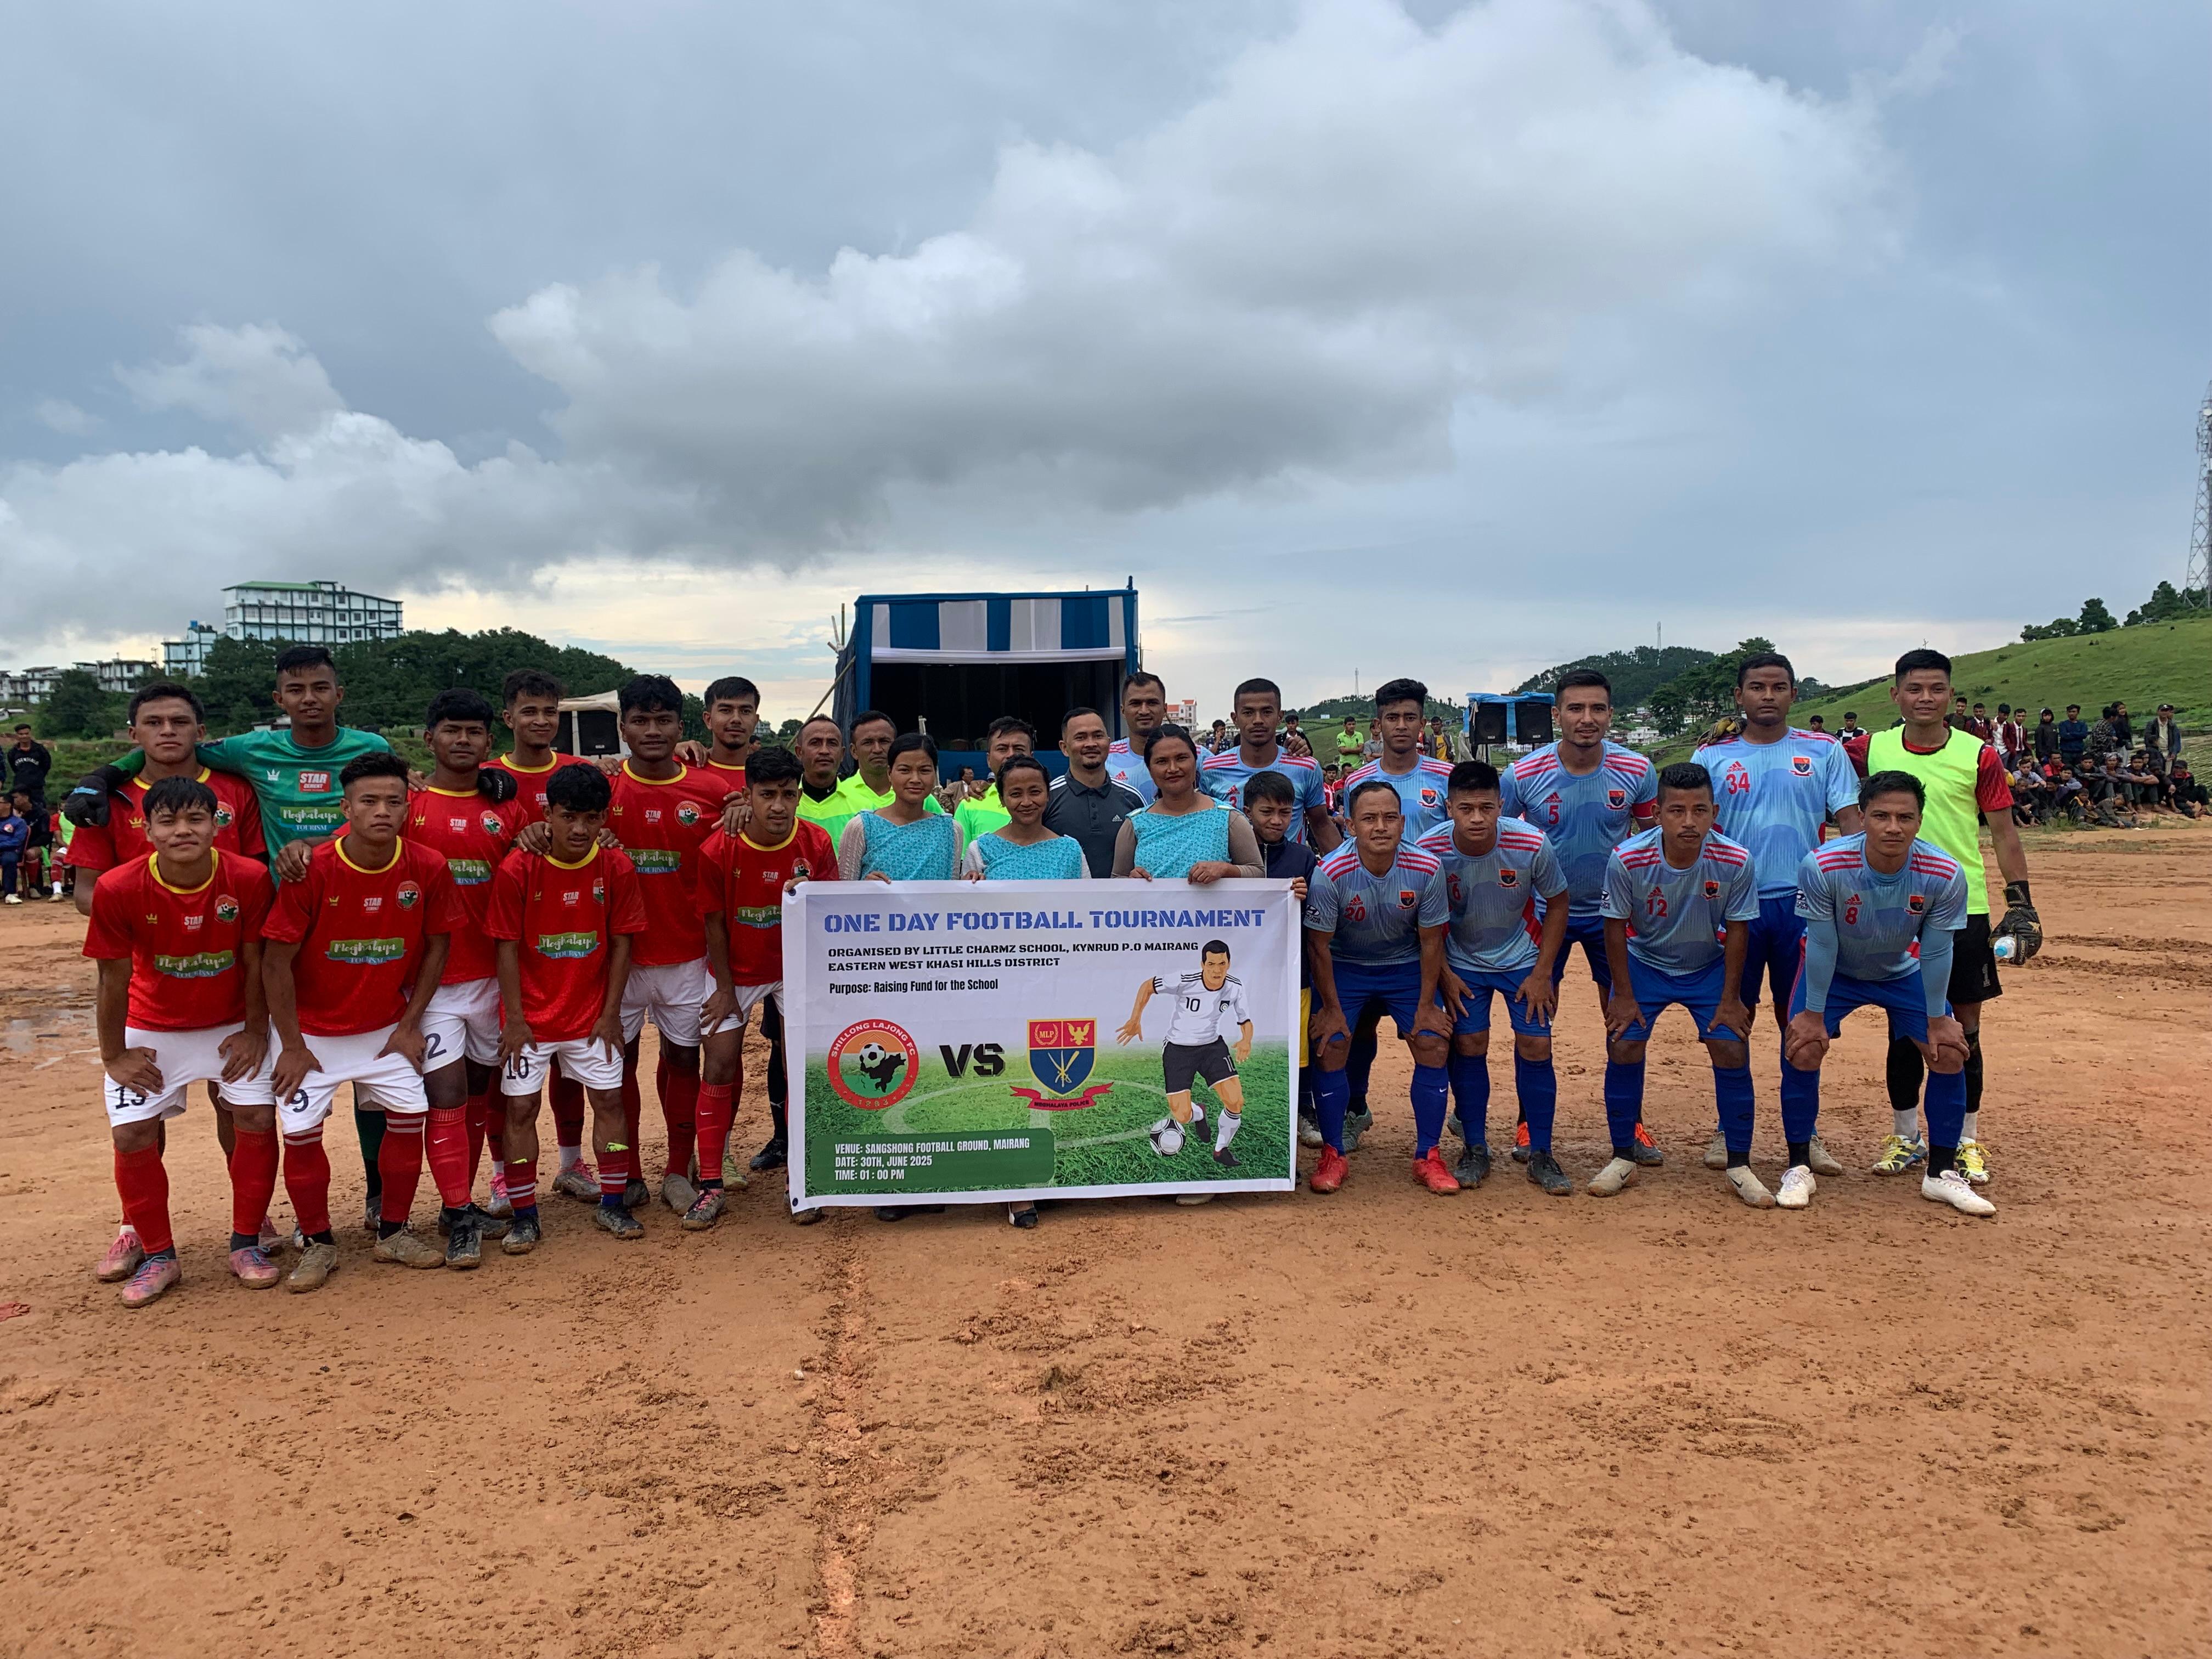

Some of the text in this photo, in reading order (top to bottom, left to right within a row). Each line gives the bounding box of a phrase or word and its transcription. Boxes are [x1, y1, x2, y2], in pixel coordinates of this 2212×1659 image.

[300, 773, 328, 783] STAR
[1726, 772, 1750, 794] 34
[535, 793, 549, 802] STA
[283, 808, 337, 823] Meghalaya
[645, 810, 661, 819] STAR
[1548, 805, 1559, 825] 5
[450, 818, 466, 827] STAR
[763, 871, 778, 879] STAR
[364, 898, 382, 907] STAR
[563, 891, 579, 901] STAR
[1344, 906, 1365, 922] 20
[1647, 899, 1668, 917] 12
[184, 915, 204, 926] STAR
[825, 910, 1265, 933] ONE DAY FOOTBALL TOURNAMENT
[1845, 907, 1858, 925] 8
[334, 940, 396, 956] Meghalaya
[828, 942, 1199, 957] ORGANISED BY LITTLE CHARMZ SCHOOL, KYNRUD P.O MAIRANG
[828, 958, 1060, 972] EASTERN WEST KHASI HILLS DISTRICT
[830, 978, 998, 995] Purpose: Raising Fund for the School
[1186, 997, 1200, 1012] 10
[425, 1033, 447, 1059] 2
[831, 1022, 916, 1058] SHILLONG LAJONG FC
[506, 1055, 529, 1079] 10
[939, 1043, 1005, 1079] VS
[290, 1089, 308, 1113] 9
[835, 1138, 1030, 1154] VENUE: SANGSHONG FOOTBALL GROUND, MAIRANG
[835, 1155, 932, 1168] DATE: 30TH, JUNE 2025
[834, 1170, 858, 1181] TIME:
[891, 1169, 905, 1180] PM
